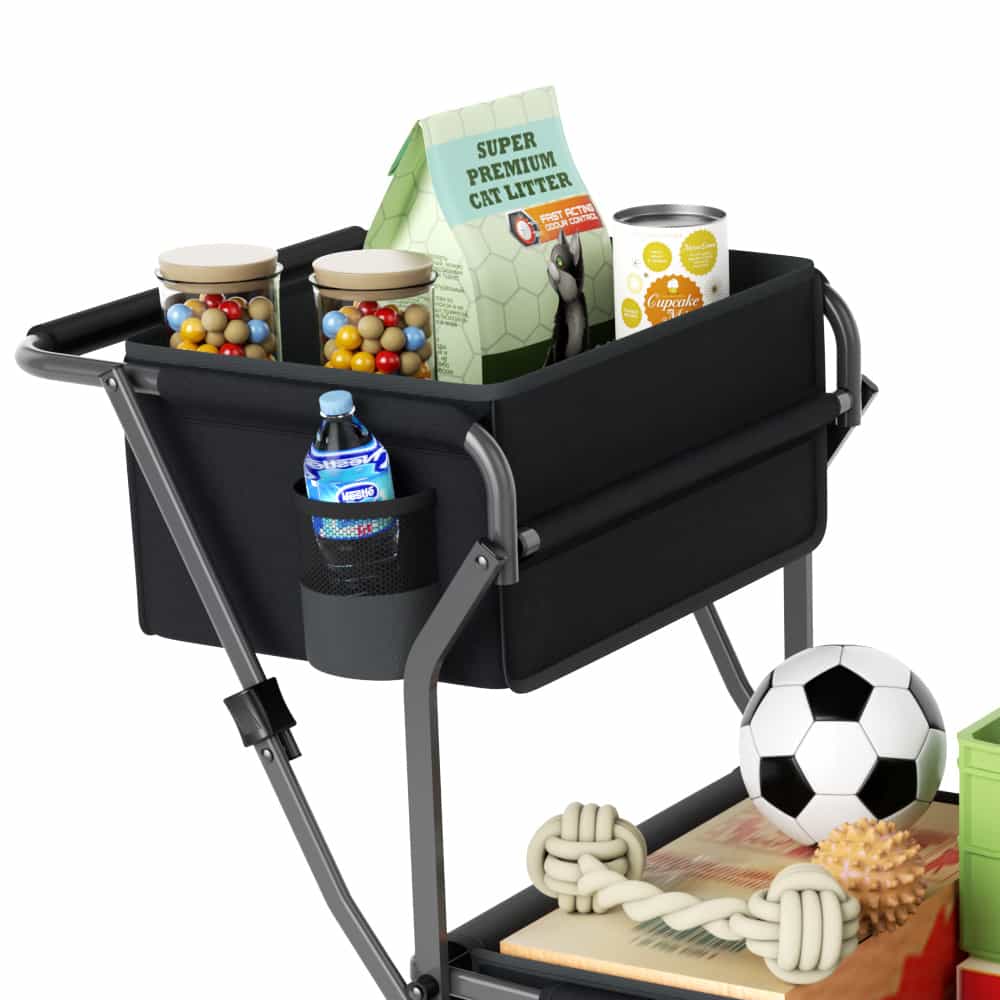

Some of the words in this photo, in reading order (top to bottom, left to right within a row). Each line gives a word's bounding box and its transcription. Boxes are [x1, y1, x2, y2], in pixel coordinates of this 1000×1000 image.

[477, 131, 537, 159] SUPER
[466, 151, 557, 186] PREMIUM
[469, 187, 503, 209] CAT
[503, 172, 573, 200] LITTER
[540, 210, 562, 223] FAST
[647, 293, 700, 311] Cupcake
